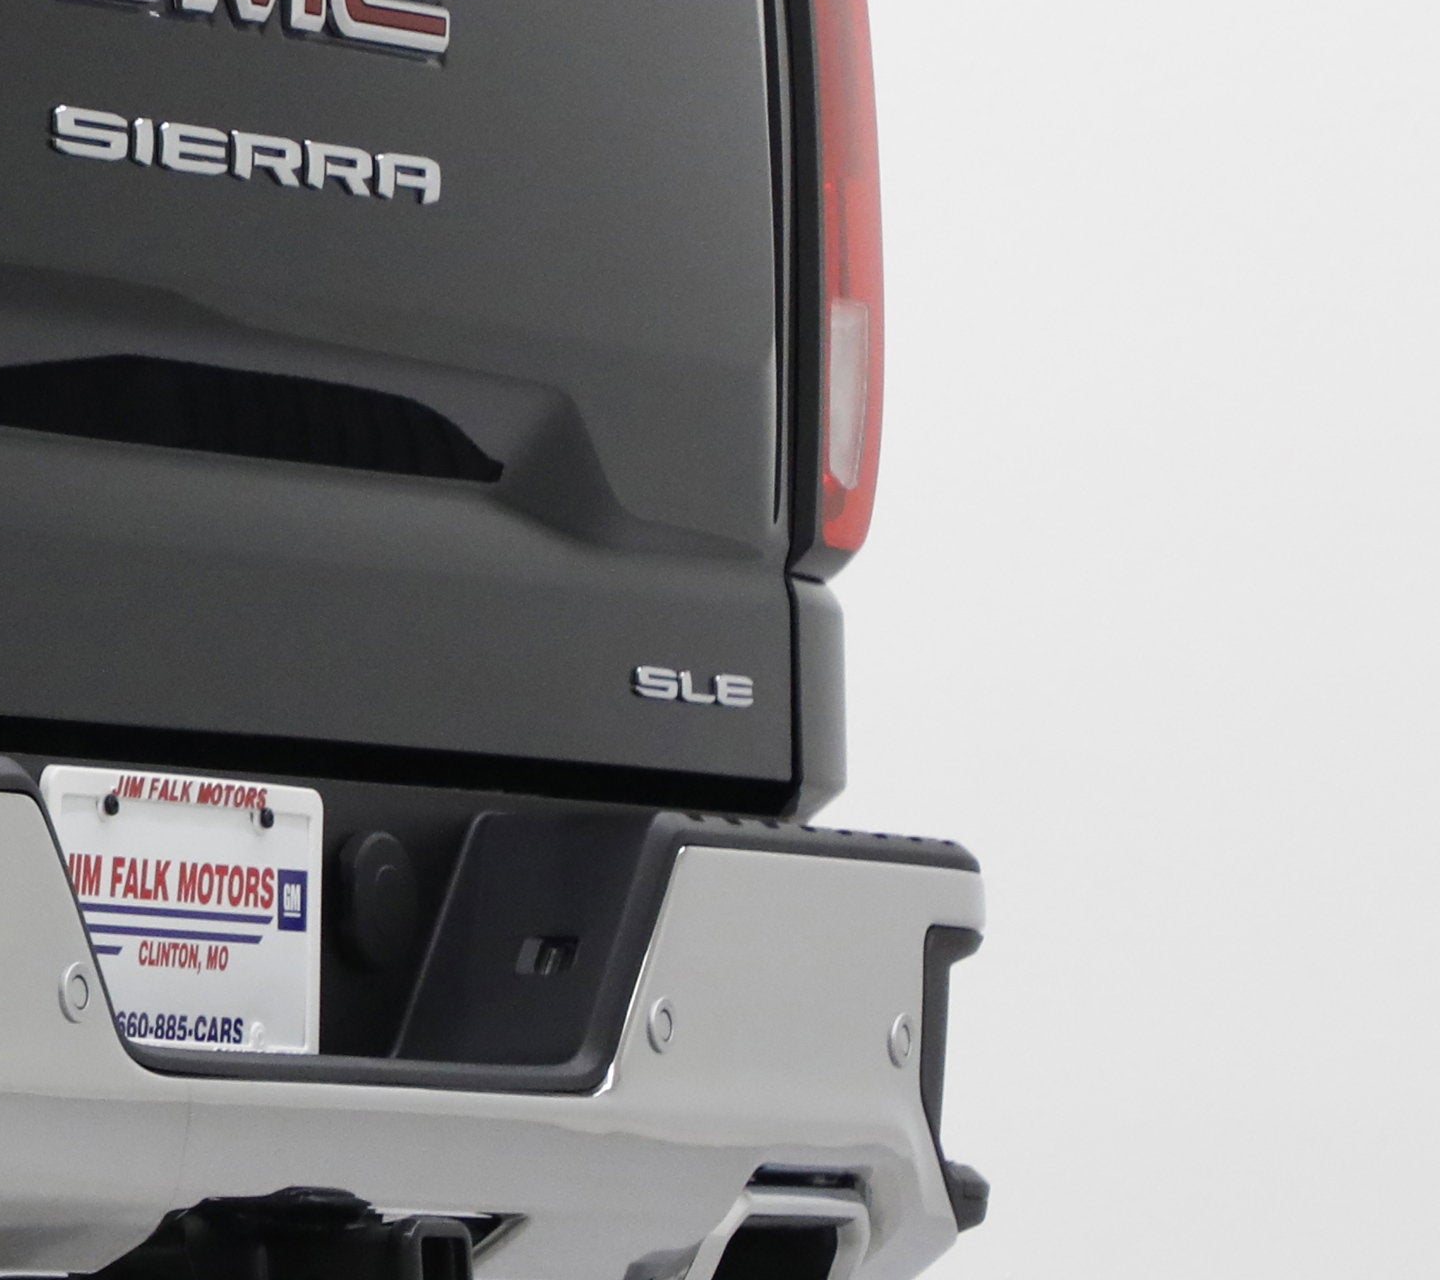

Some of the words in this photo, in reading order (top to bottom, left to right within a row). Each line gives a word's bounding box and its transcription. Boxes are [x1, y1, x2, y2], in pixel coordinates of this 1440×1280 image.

[51, 104, 442, 205] SIERRA
[635, 665, 754, 708] SLE
[111, 774, 145, 799] JIM
[148, 777, 193, 803] FALK
[196, 781, 268, 810] MOTORS
[109, 856, 171, 902] FALK
[178, 861, 275, 910] MOTORS
[282, 883, 302, 914] GM
[138, 941, 201, 974] CLINTON,
[205, 946, 229, 971] MO
